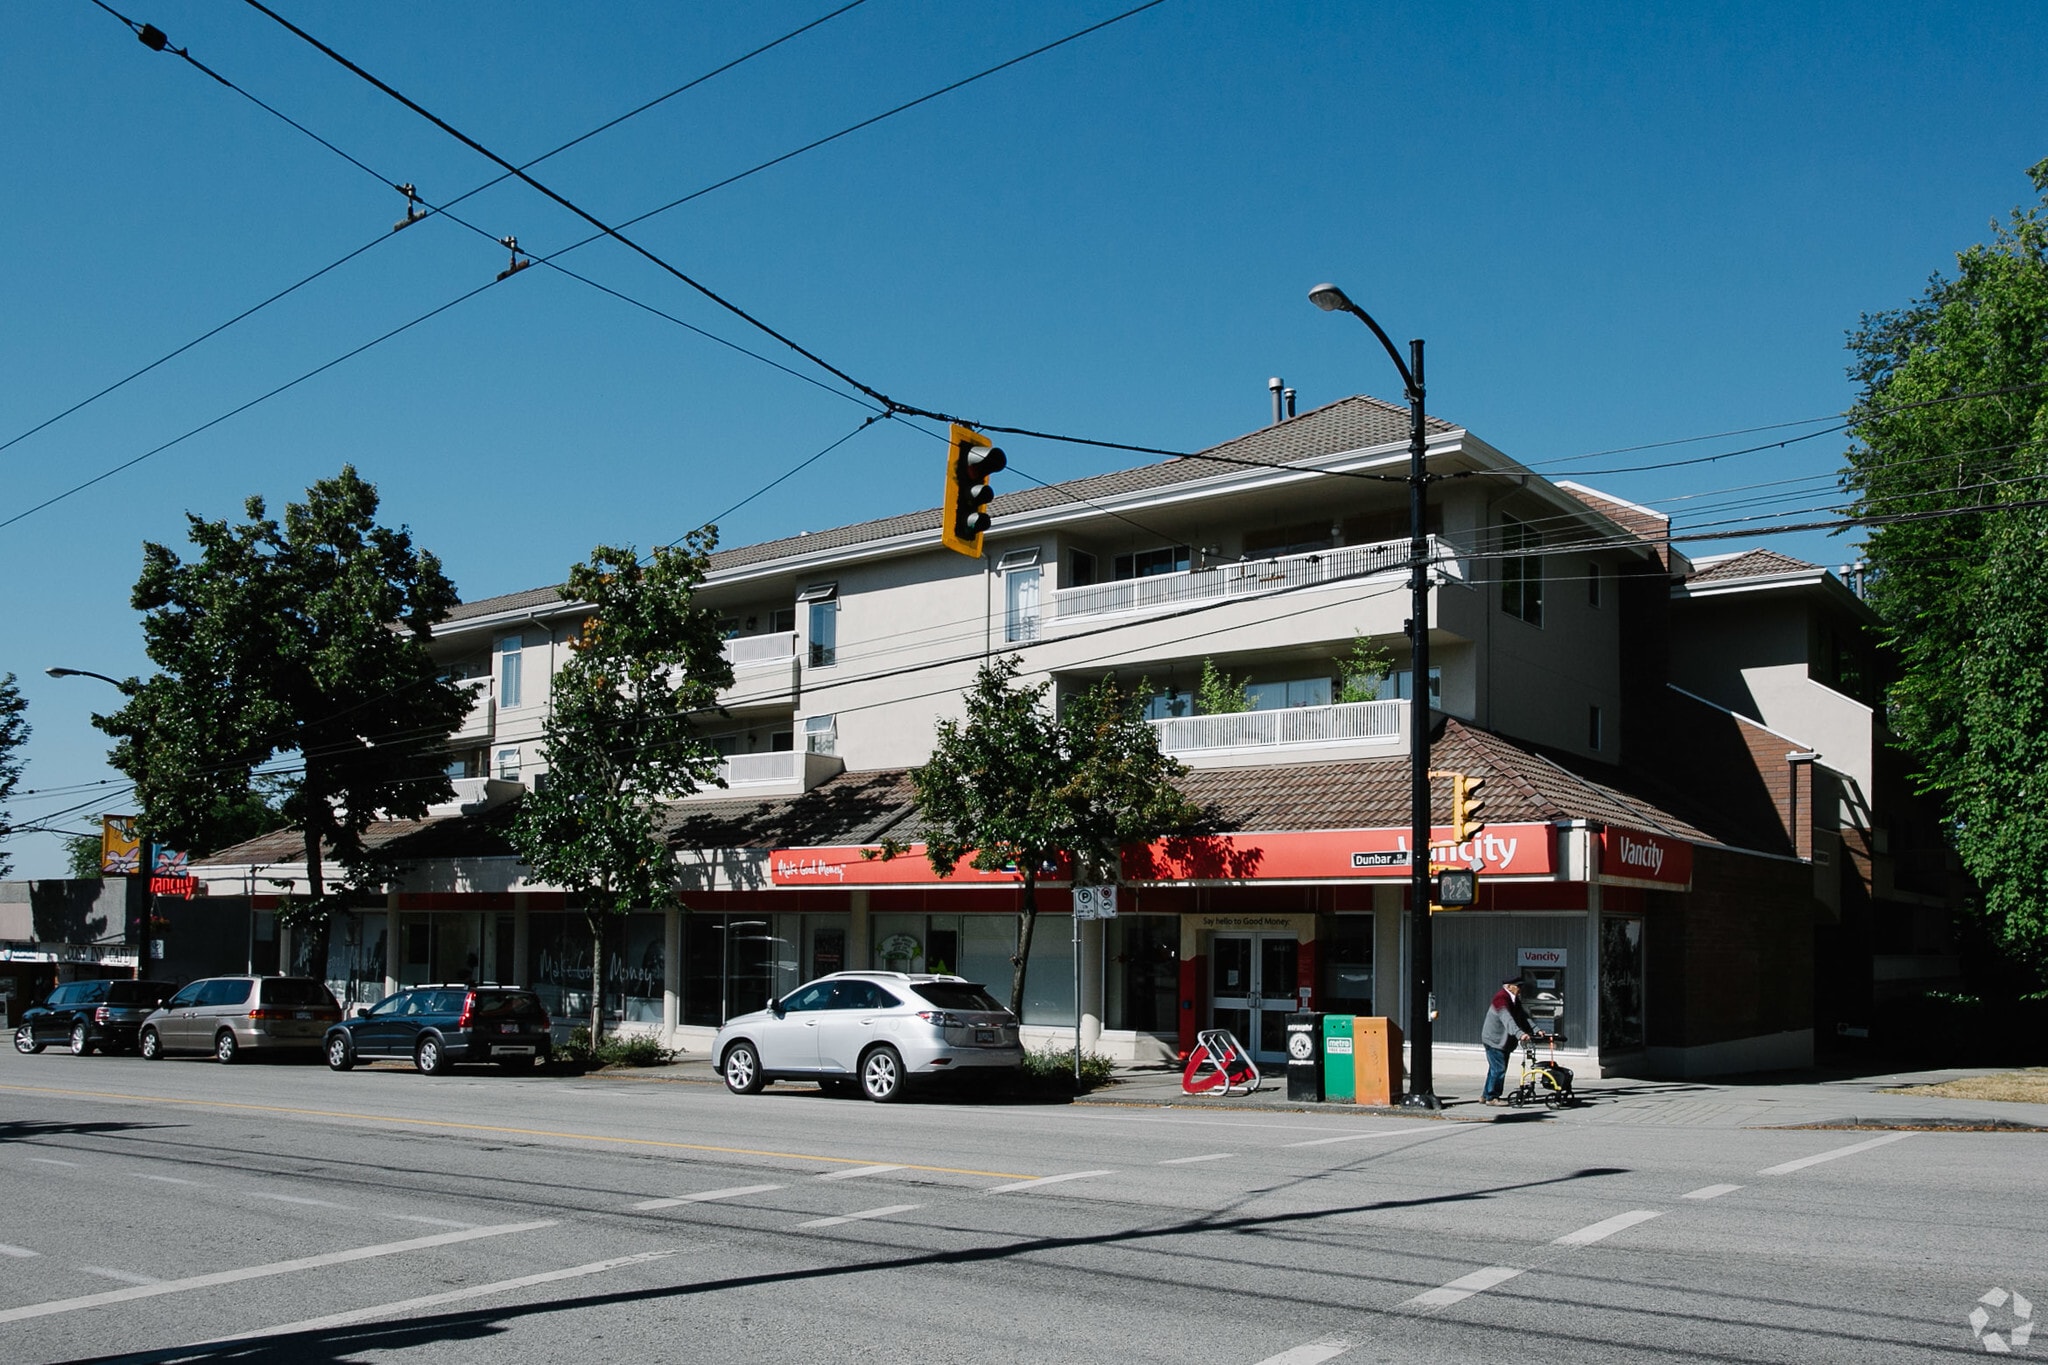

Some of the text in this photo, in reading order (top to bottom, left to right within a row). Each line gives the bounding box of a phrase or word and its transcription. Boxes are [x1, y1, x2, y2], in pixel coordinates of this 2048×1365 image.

[1398, 832, 1518, 870] ncity
[1620, 836, 1664, 876] Vancity
[1355, 854, 1391, 865] Dunbar
[778, 859, 799, 879] Make
[800, 859, 818, 876] Good
[1203, 917, 1215, 927] Say
[1215, 917, 1233, 926] hello
[1234, 918, 1242, 926] to
[1243, 917, 1263, 926] Good
[90, 945, 105, 963] INN
[1524, 951, 1560, 963] Vancity
[1329, 1039, 1351, 1048] metro
